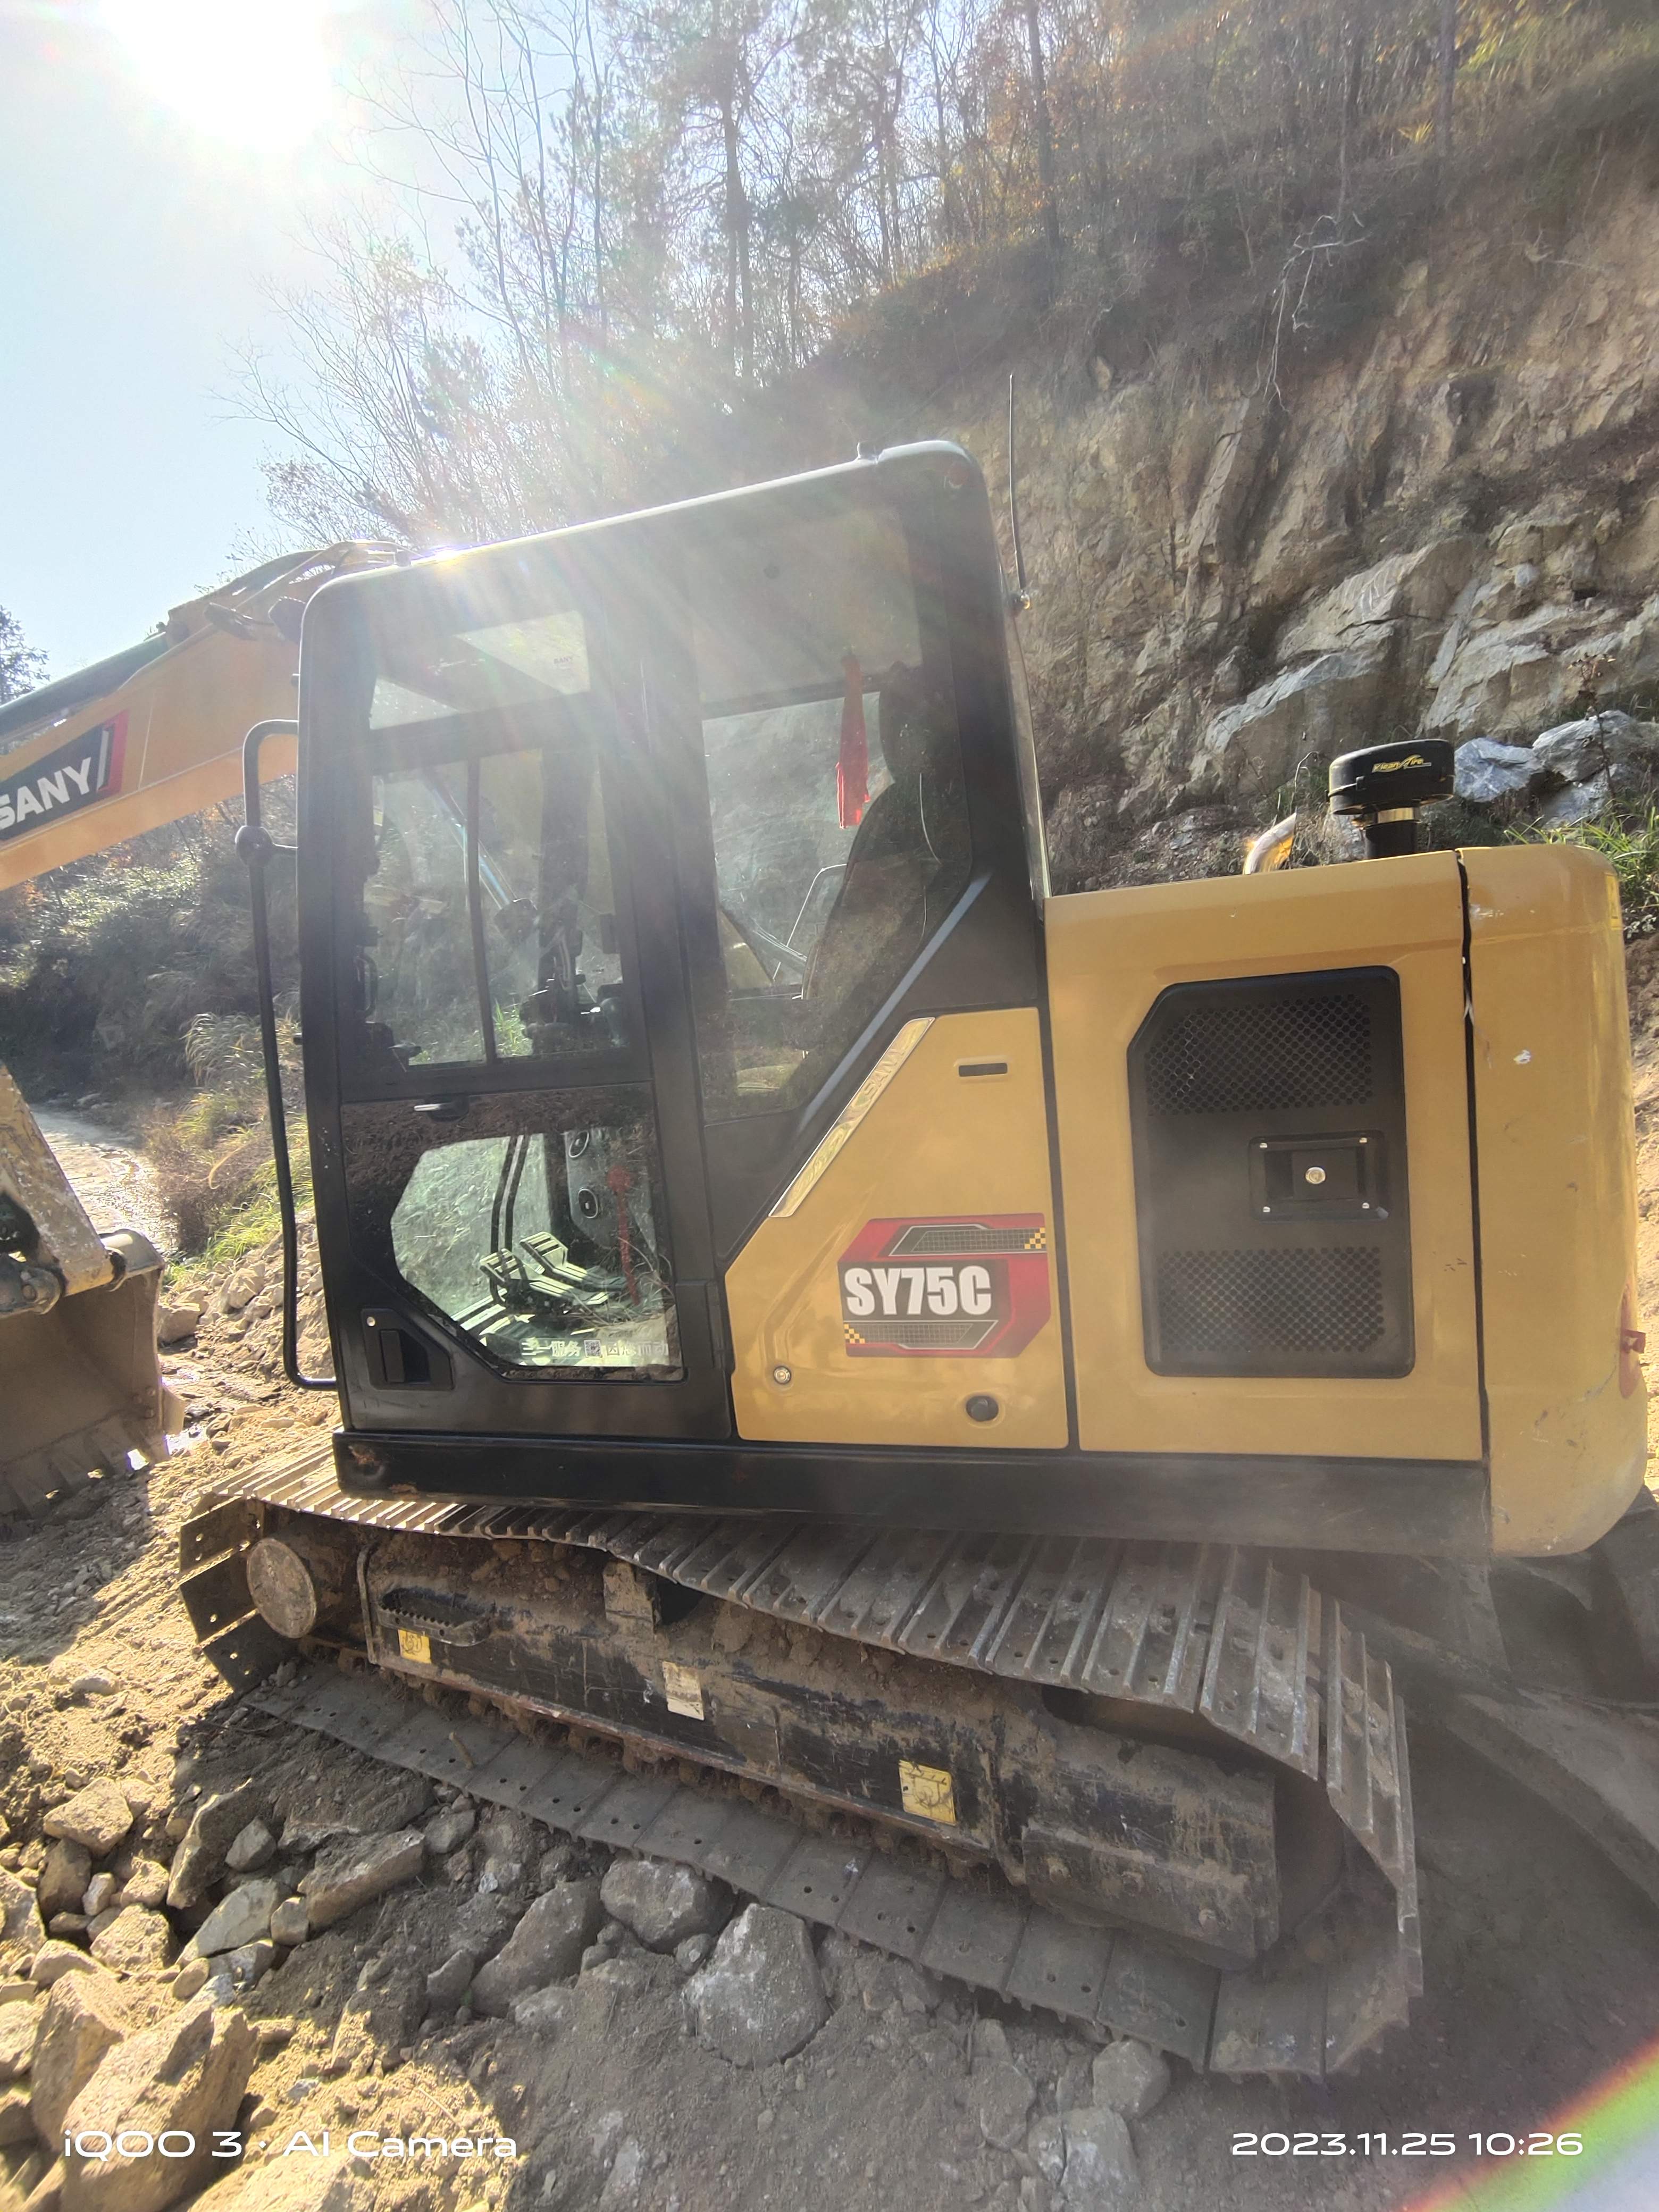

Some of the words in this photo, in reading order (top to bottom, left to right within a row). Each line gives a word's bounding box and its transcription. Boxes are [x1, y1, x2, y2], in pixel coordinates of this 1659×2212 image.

[0, 757, 91, 830] SANY
[844, 1266, 992, 1316] SY75C
[521, 1339, 582, 1356] 三一服务
